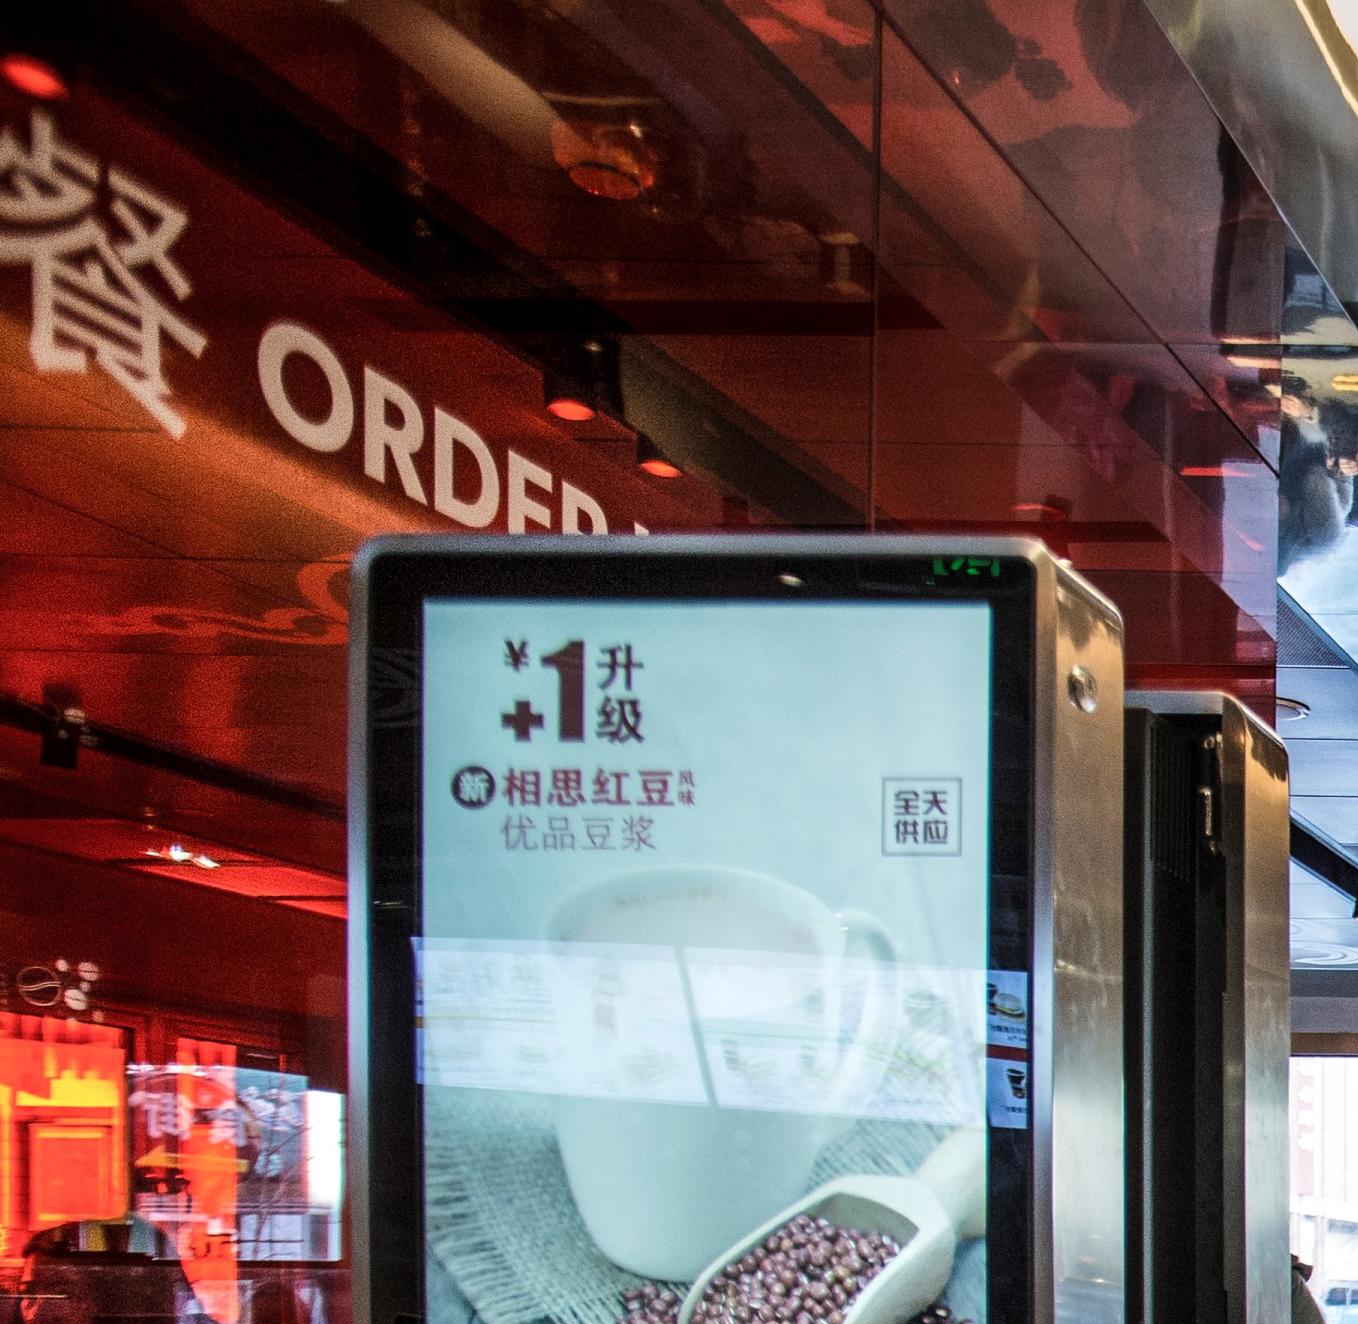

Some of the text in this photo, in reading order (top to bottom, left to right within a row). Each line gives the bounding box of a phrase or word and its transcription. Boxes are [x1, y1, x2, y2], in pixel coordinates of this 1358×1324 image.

[597, 643, 645, 743] 升级
[503, 767, 675, 807] 相思红豆
[501, 813, 656, 851] 优品豆浆
